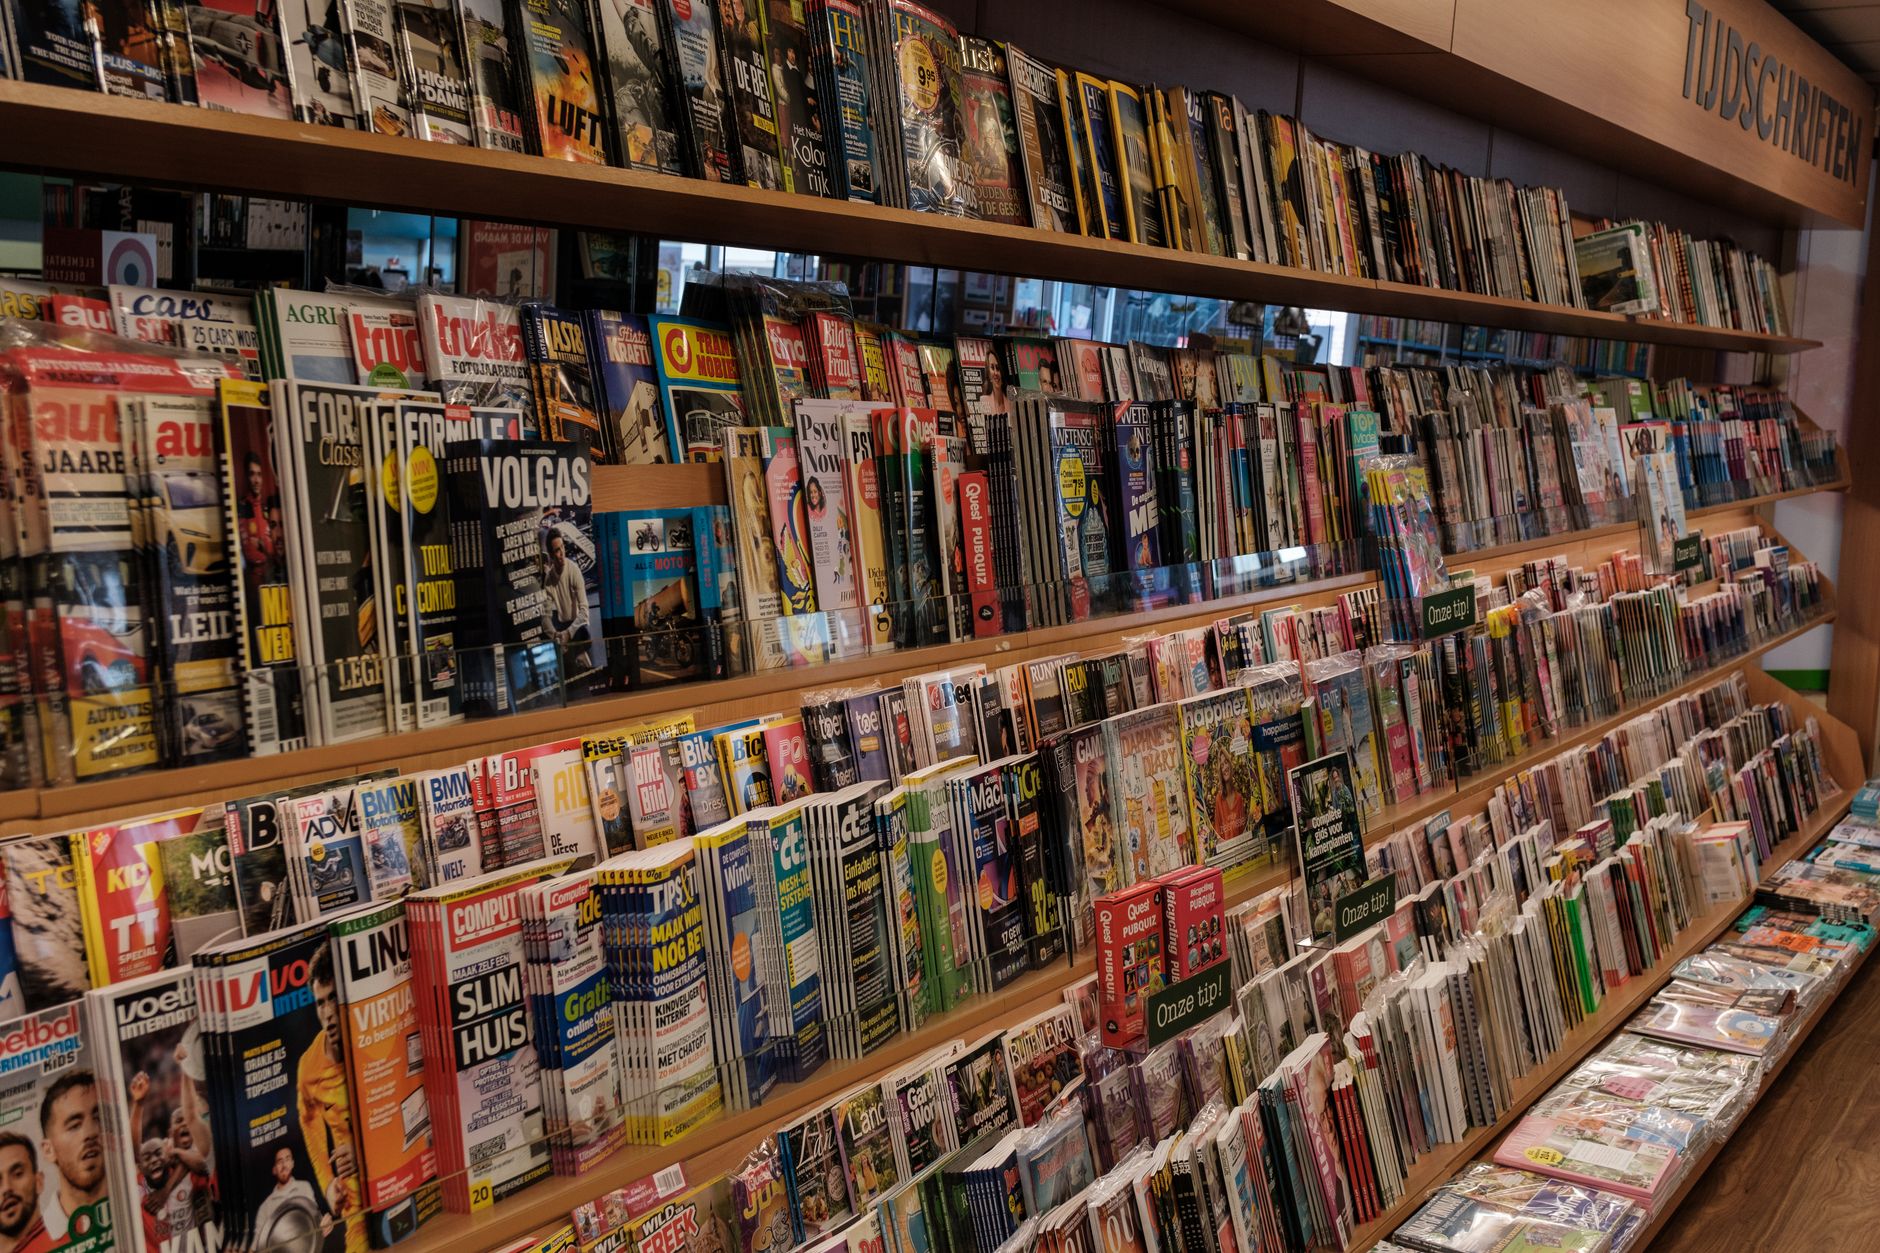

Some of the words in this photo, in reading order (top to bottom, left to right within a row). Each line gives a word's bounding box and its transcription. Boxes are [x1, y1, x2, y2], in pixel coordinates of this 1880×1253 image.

[357, 19, 384, 37] MODELS
[366, 12, 383, 27] YOUR
[1683, 0, 1862, 187] TIJDSCHRIFTEN
[793, 123, 805, 137] Het
[807, 169, 831, 198] rijk
[130, 294, 214, 321] cars
[286, 302, 337, 326] AGRI
[193, 326, 205, 344] 25
[207, 327, 235, 347] CARS
[434, 303, 525, 362] trucks
[452, 359, 531, 380] FOTOJAARBOEK
[904, 412, 939, 445] Quest
[1351, 413, 1374, 433] TOP
[481, 456, 591, 509] VOLGAS
[965, 482, 982, 521] Quest
[971, 527, 987, 585] PUBQUIZ
[1428, 602, 1452, 626] Onze
[1455, 594, 1470, 618] tip!
[1181, 697, 1249, 730] happinez
[1143, 746, 1177, 776] DIARY
[361, 781, 415, 818] BMW
[1311, 808, 1342, 829] Complete
[1314, 829, 1328, 845] gids
[1328, 821, 1343, 836] voor
[550, 833, 562, 848] DE
[1308, 830, 1354, 859] kamerplanten
[441, 858, 466, 881] WELT-
[551, 882, 589, 907] Computer
[647, 876, 683, 915] TIPS
[1189, 882, 1214, 898] Bicycling
[1189, 890, 1216, 912] PUBQUIZ
[1127, 898, 1150, 922] Quest
[1342, 902, 1368, 927] Onze
[1371, 886, 1389, 912] tip!
[110, 908, 160, 955] TT
[344, 915, 379, 933] ALLES
[652, 917, 684, 945] MAAK
[1099, 909, 1113, 945] Quest
[1122, 914, 1157, 938] PUBQUIZ
[1166, 889, 1179, 956] Bicycling
[453, 967, 478, 982] MAAK
[478, 958, 496, 974] ZELF
[495, 953, 509, 968] EEN
[652, 939, 687, 972] NOG
[685, 955, 699, 970] APPS
[653, 981, 674, 997] VOOR
[673, 973, 688, 989] EXTRA
[1104, 949, 1115, 1002] PUBQUIZ
[456, 965, 521, 1021] SLIM
[655, 985, 700, 1017] KINDVEILIGER
[1156, 993, 1195, 1028] Onze
[1198, 974, 1223, 1008] tip!
[566, 1017, 595, 1039] online
[655, 1003, 691, 1029] INTERNET
[357, 1032, 371, 1049] Zo
[460, 1008, 527, 1066] HUIS
[658, 1053, 677, 1069] MET
[678, 1032, 707, 1060] CHATGPT
[1009, 1013, 1075, 1070] BUITENLEVEN
[43, 1050, 77, 1074] KIDS
[245, 1067, 272, 1086] KROON
[973, 1094, 1007, 1126] Complete
[472, 1185, 489, 1205] 20
[638, 1206, 698, 1253] FREEK
[643, 1203, 675, 1237] WILD
